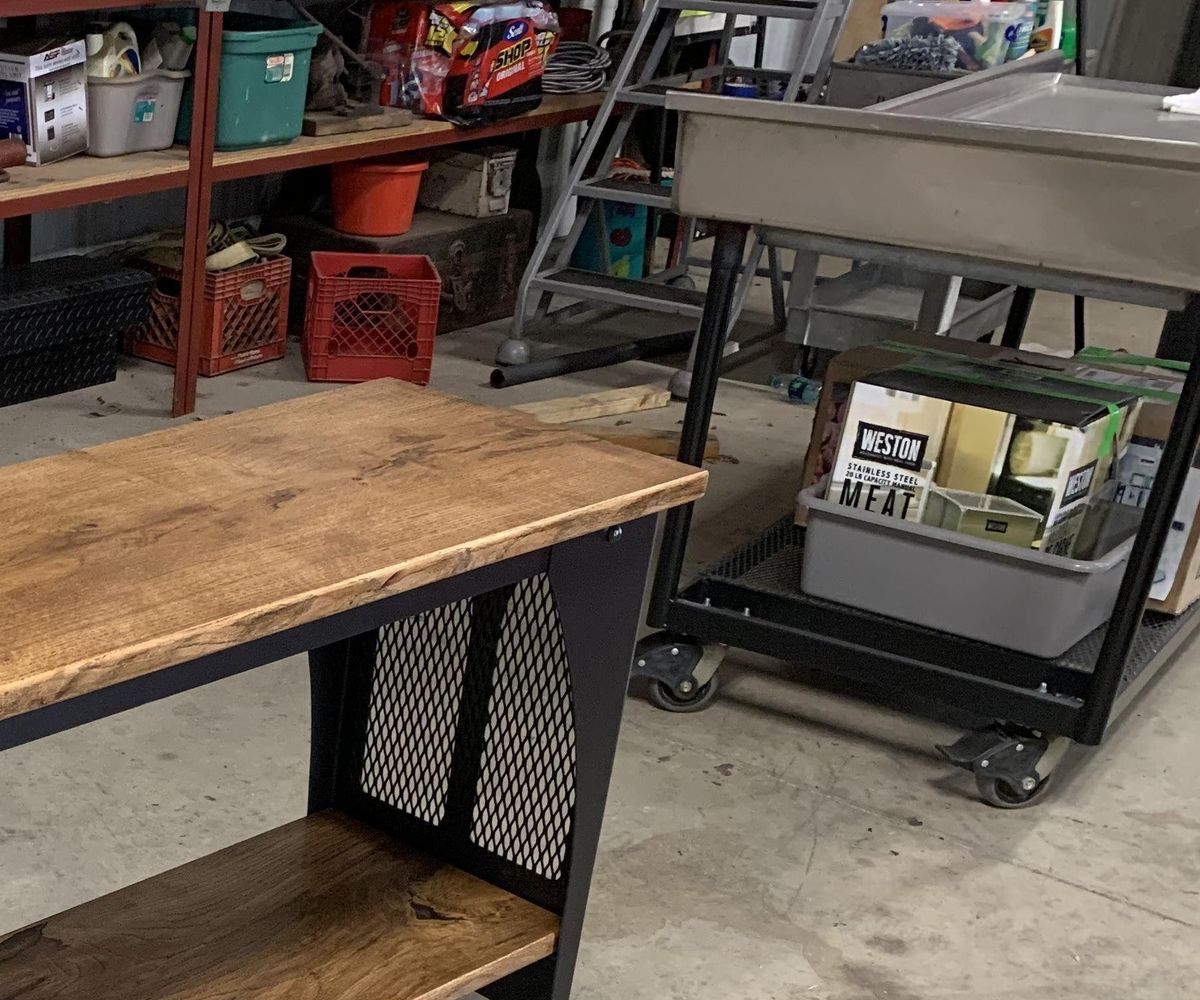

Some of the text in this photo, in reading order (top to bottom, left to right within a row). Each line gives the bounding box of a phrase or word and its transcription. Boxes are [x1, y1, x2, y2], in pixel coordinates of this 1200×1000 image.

[44, 49, 61, 62] ASF
[494, 38, 532, 71] SHOP
[861, 428, 922, 462] WESTON
[845, 470, 854, 478] 20
[863, 474, 891, 487] CAPACITY
[847, 462, 919, 486] STAINLESS STEEL
[839, 478, 915, 520] MEAT
